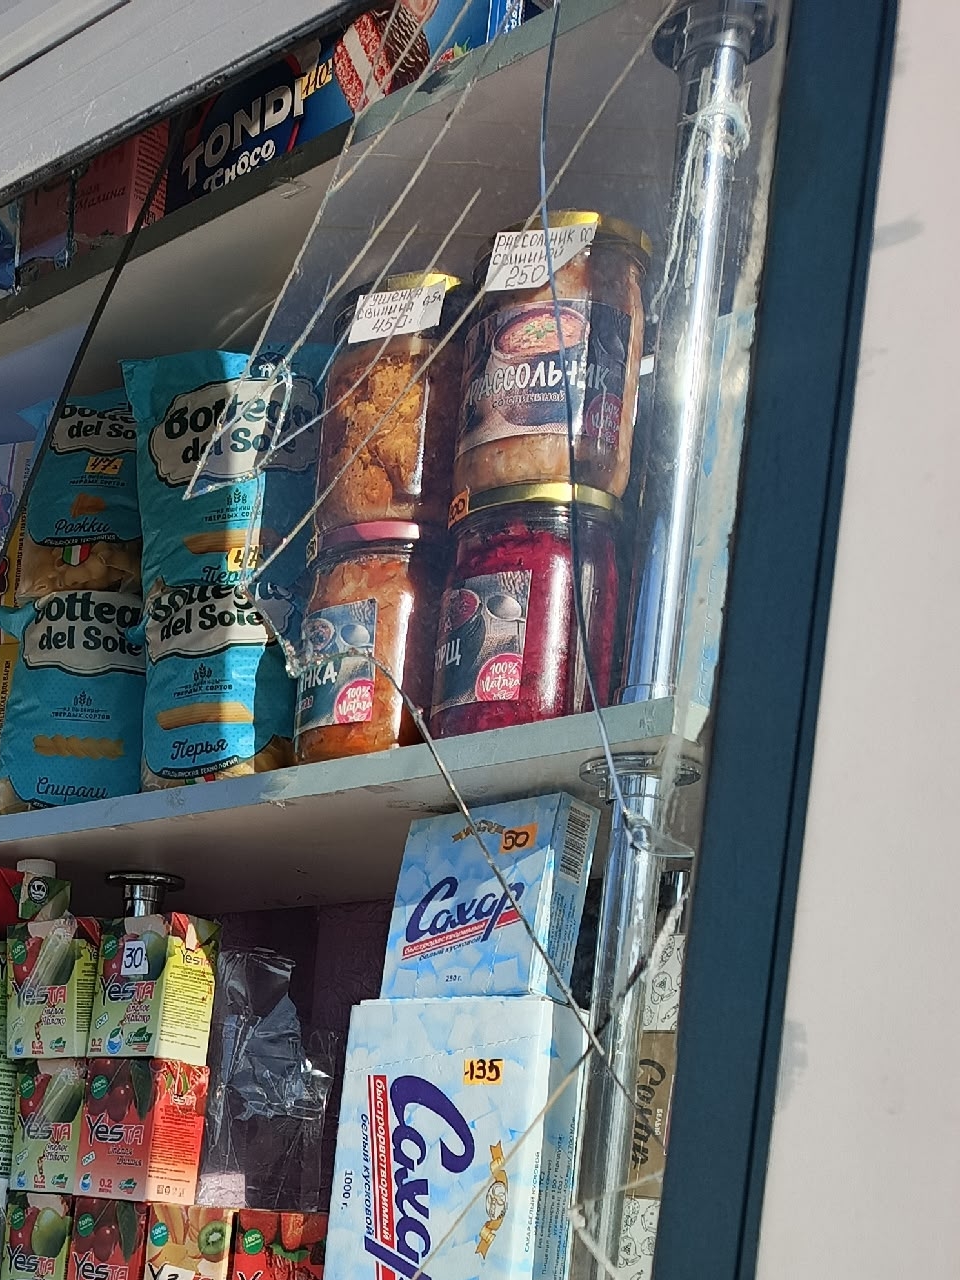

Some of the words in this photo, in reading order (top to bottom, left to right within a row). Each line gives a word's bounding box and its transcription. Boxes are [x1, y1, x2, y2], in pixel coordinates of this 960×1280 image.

[181, 79, 304, 190] TONDI
[495, 229, 575, 252] РАССОЛНИК
[68, 421, 104, 440] del
[106, 423, 137, 440] So
[55, 517, 111, 536] Рожки
[34, 591, 141, 631] otteg
[39, 625, 76, 651] del
[160, 613, 192, 642] del
[489, 662, 518, 675] 100%
[346, 685, 370, 699] 100%
[171, 738, 229, 764] Перья
[36, 776, 109, 803] Спирали
[503, 829, 530, 851] 50
[405, 876, 526, 944] Сахар
[125, 946, 144, 969] 30
[360, 1113, 370, 1165] белый
[375, 1078, 392, 1241] быстрорастворимый
[33, 1174, 45, 1184] 0.2
[100, 1178, 113, 1189] 0.2
[343, 1169, 354, 1200] 1000
[362, 1165, 376, 1236] кусковой
